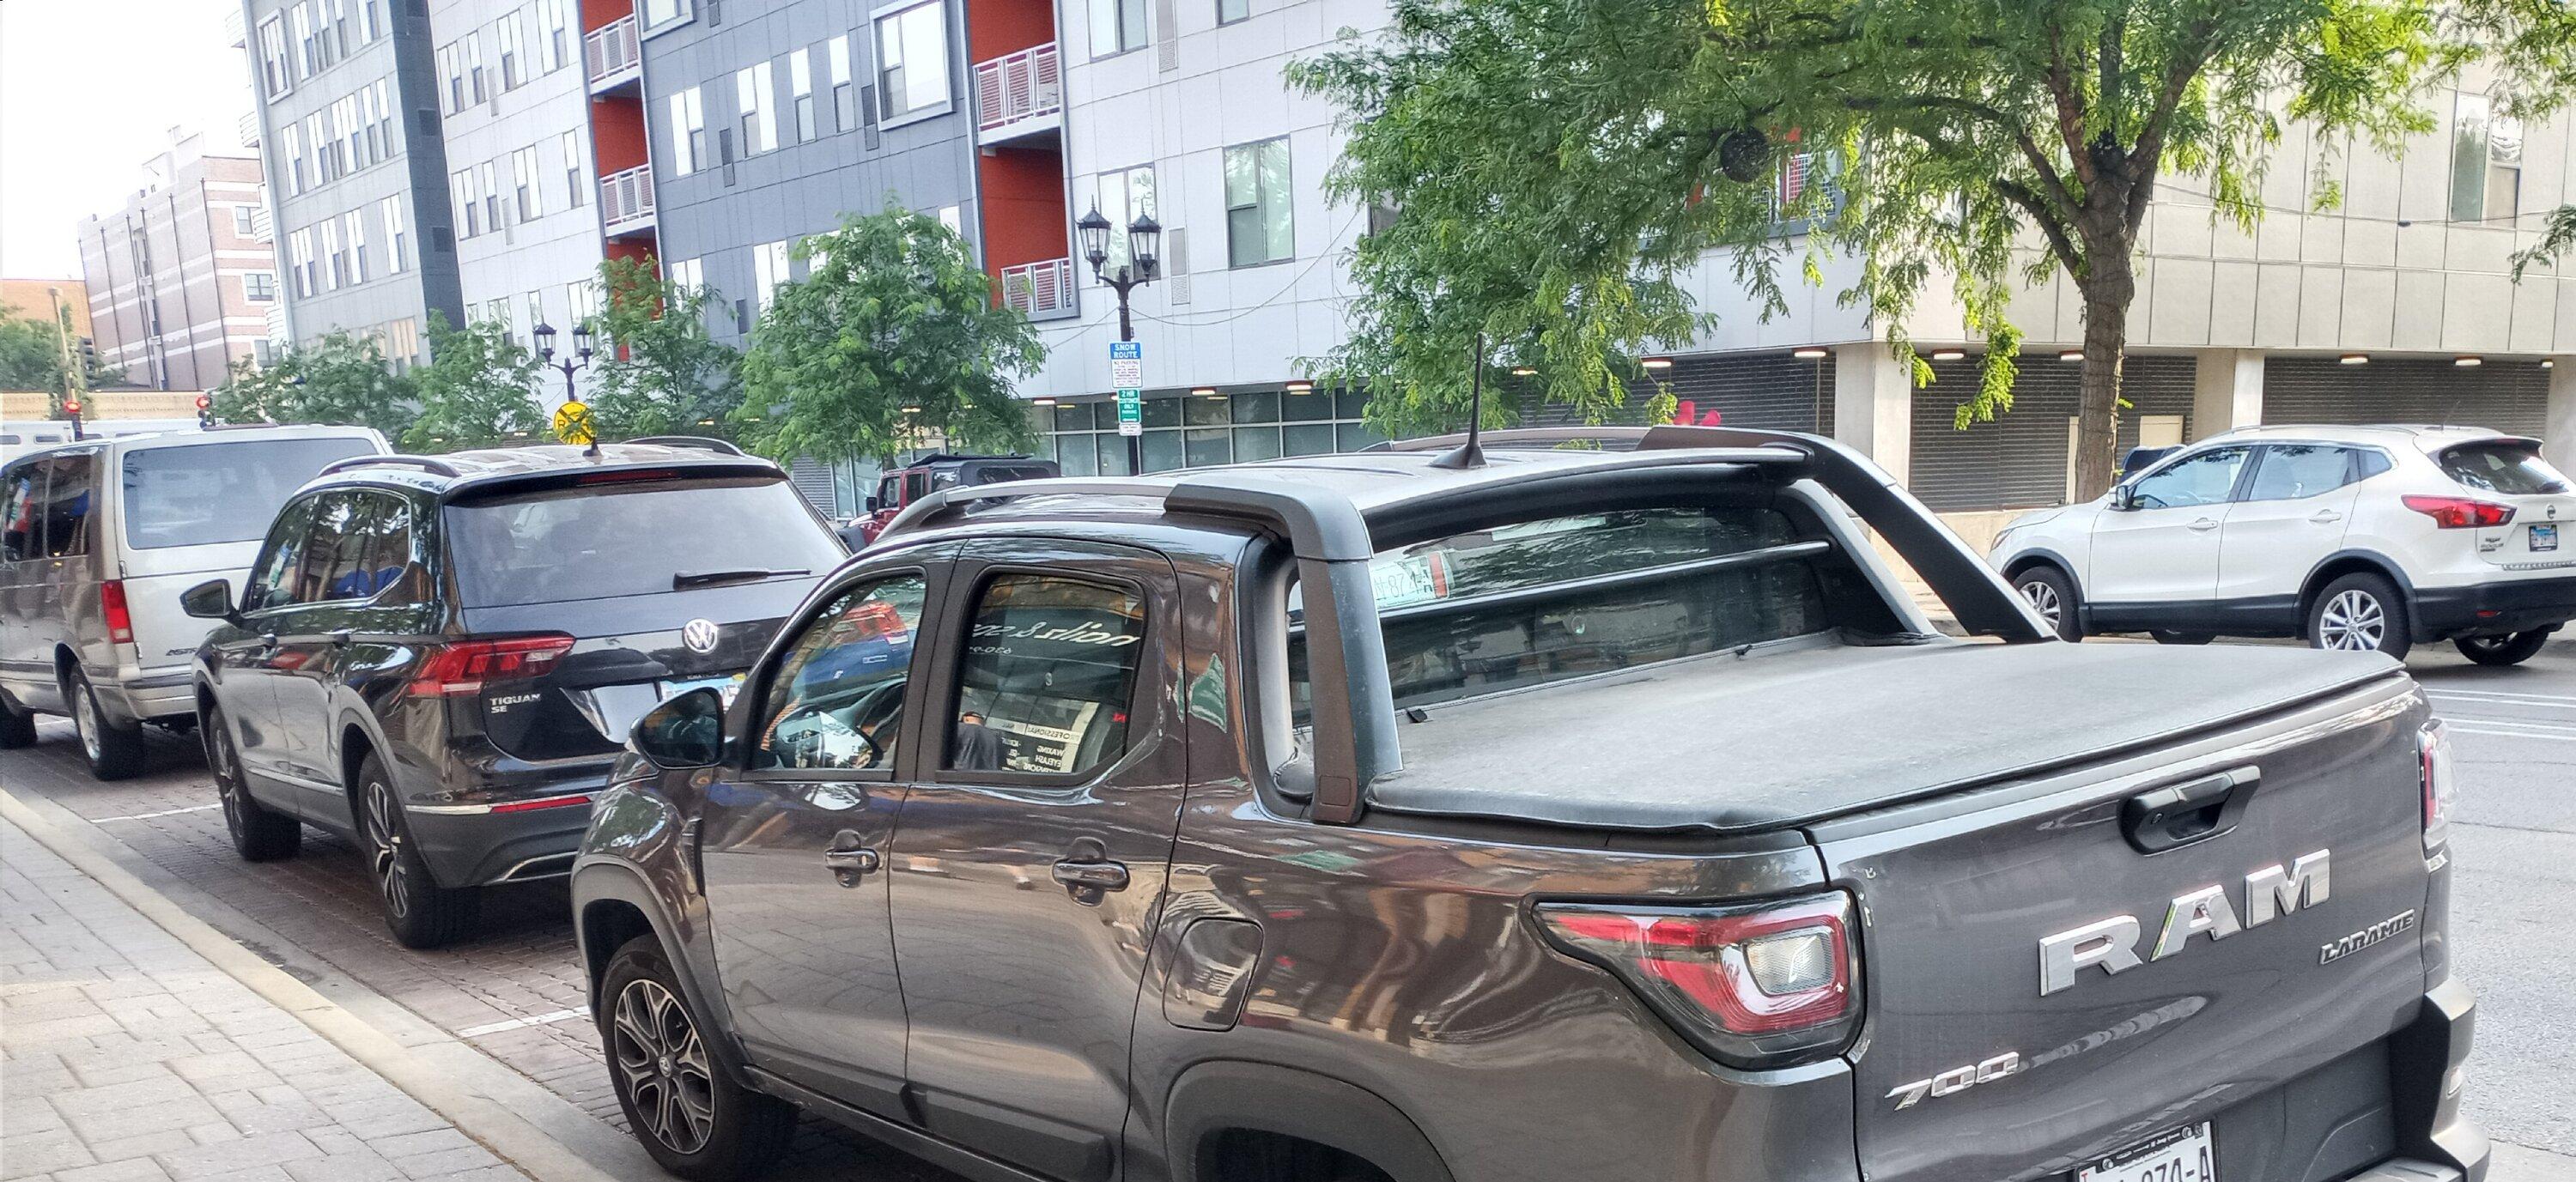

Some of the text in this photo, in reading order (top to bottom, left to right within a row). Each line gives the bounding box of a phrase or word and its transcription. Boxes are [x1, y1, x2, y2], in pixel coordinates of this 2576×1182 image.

[1113, 350, 1139, 359] ROUTE
[489, 694, 541, 706] TIGUAN
[490, 705, 507, 714] SE
[2038, 848, 2331, 997] RAM
[2319, 908, 2415, 965] LARAMIE
[1885, 1052, 2019, 1111] 700
